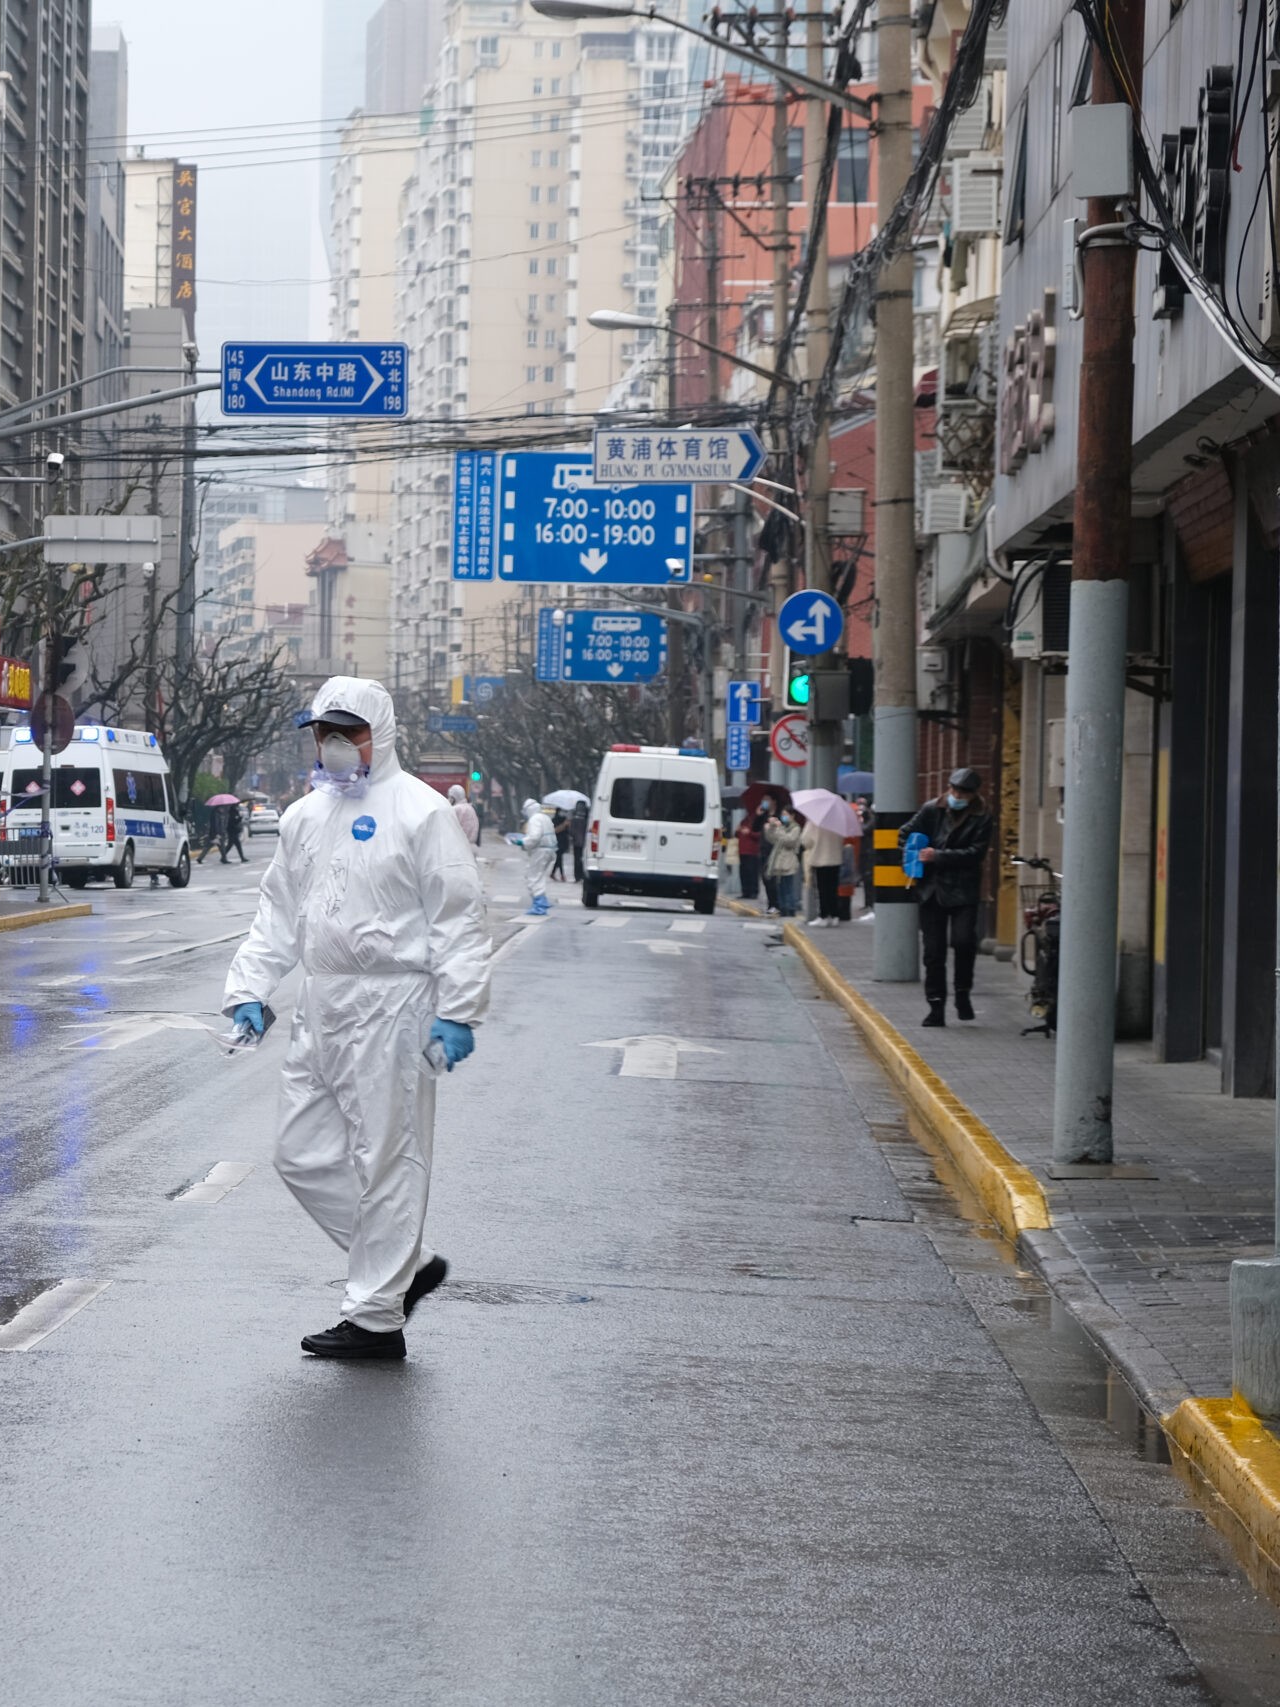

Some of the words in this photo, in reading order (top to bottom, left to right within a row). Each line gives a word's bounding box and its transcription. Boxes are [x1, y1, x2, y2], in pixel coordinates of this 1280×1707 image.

[227, 350, 245, 365] 145
[380, 350, 402, 366] 255
[228, 367, 242, 382] 南
[270, 362, 357, 383] 山东中路
[387, 368, 402, 383] 北
[273, 385, 322, 400] Shandong
[227, 394, 246, 409] 180
[383, 396, 402, 410] 198
[606, 437, 730, 461] 黄浦体育馆
[600, 464, 638, 478] HUANG
[644, 464, 658, 477] PU
[661, 464, 732, 477] GYMNASIUM
[91, 825, 104, 834] 120
